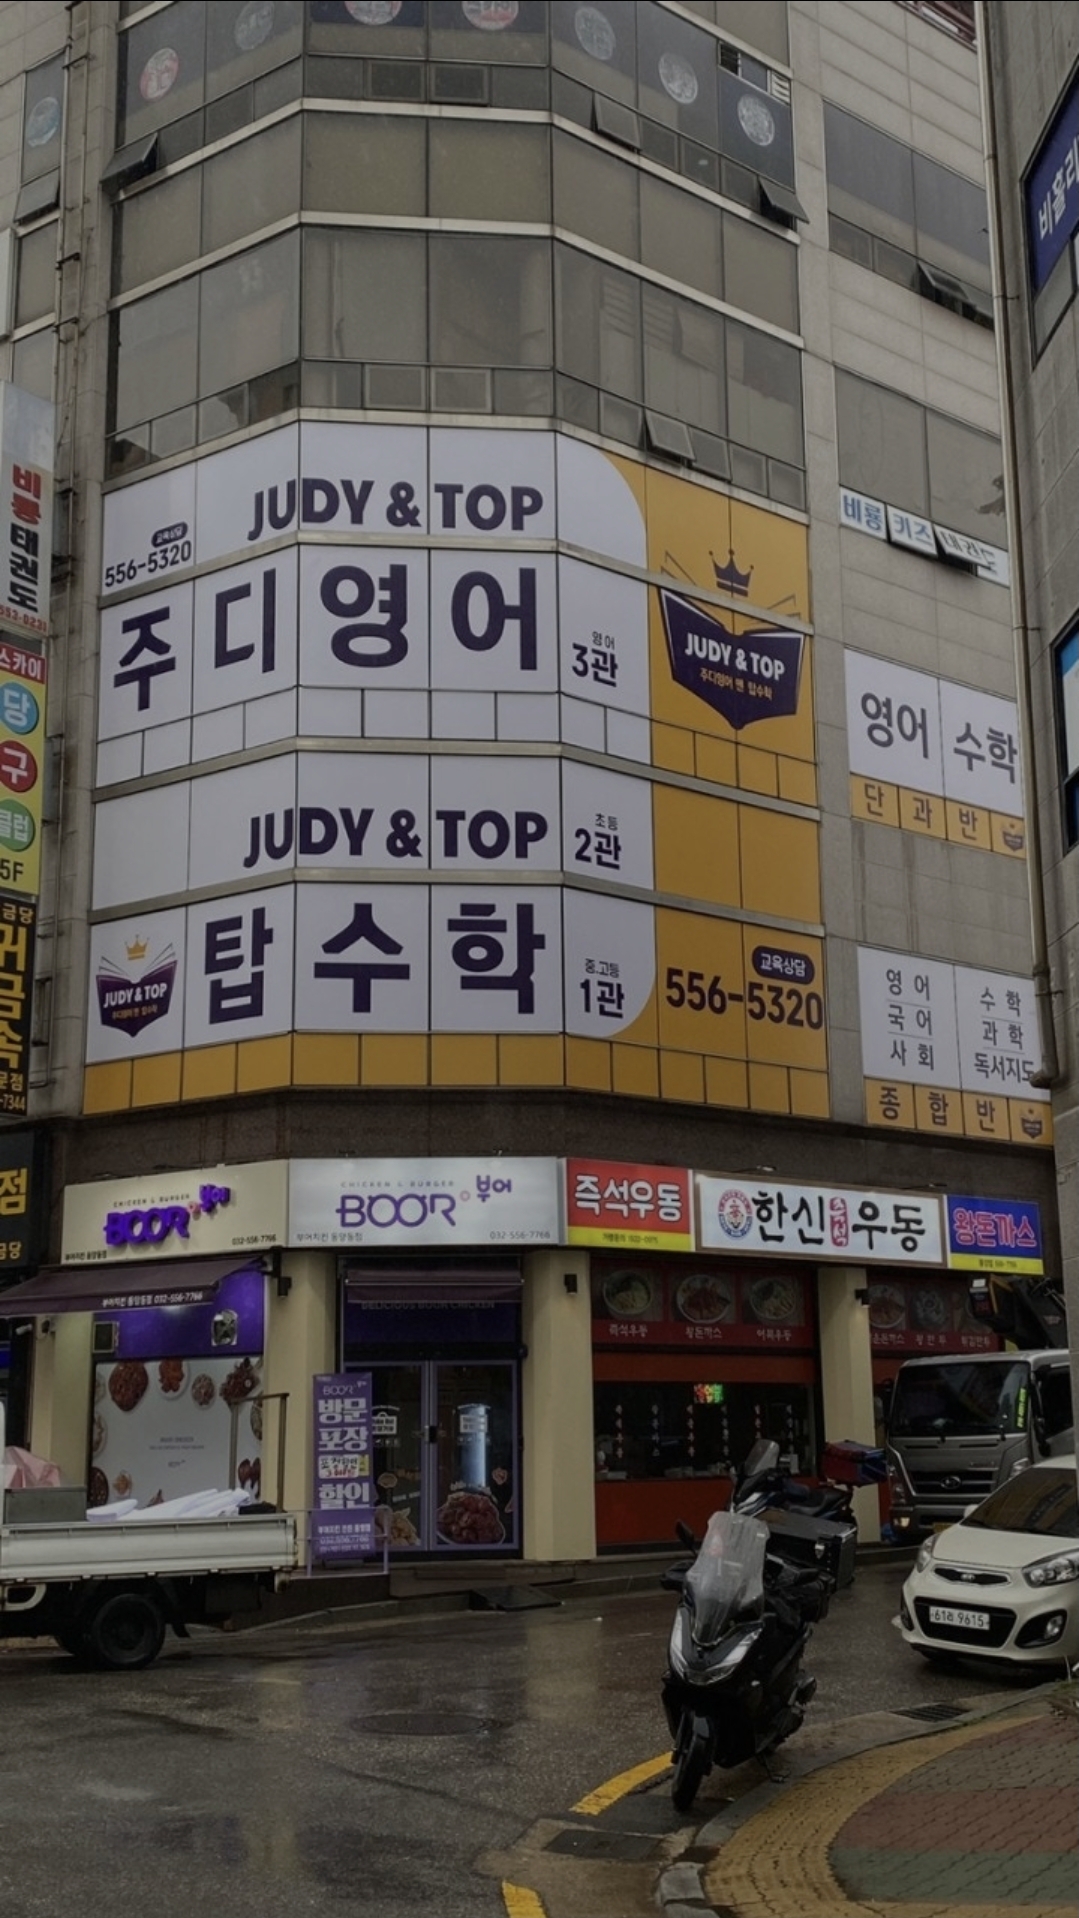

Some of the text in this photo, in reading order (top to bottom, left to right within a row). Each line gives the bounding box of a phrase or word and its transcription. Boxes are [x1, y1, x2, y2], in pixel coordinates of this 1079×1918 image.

[248, 477, 543, 541] JUDY & TOP
[843, 494, 883, 532] 비룡
[892, 511, 934, 547] 키즈
[104, 540, 192, 588] 556-5320
[113, 564, 538, 712] 주디영어
[592, 631, 615, 650] 영어
[685, 631, 785, 681] JUDY & TOP
[571, 643, 619, 688] 3관
[861, 692, 1018, 785] 영어 수학
[243, 807, 547, 868] JUDY & TOP
[595, 813, 618, 832] 초등
[575, 827, 622, 870] 2관
[204, 903, 547, 1025] 탑수학
[760, 953, 806, 978] 교육상담
[103, 982, 168, 1009] JUDY & TOP
[580, 979, 625, 1019] 1관
[666, 967, 823, 1030] 556-5320
[886, 968, 1022, 1017] 영어 수학
[888, 1004, 1023, 1050] 국어 과학
[890, 1039, 934, 1071] 사회
[199, 1184, 231, 1212] 부어
[476, 1174, 512, 1203] 부어
[575, 1174, 682, 1222] 즉석우동
[103, 1206, 190, 1246] BOOR
[336, 1193, 457, 1228] BOOR
[752, 1190, 825, 1245] 한신
[852, 1200, 925, 1255] 우동
[953, 1207, 1037, 1248] 왕돈까스
[318, 1397, 368, 1424] 방문
[323, 1384, 354, 1396] BOOR
[318, 1425, 369, 1452] 포장
[318, 1481, 370, 1510] 할인
[957, 1611, 984, 1628] 9615
